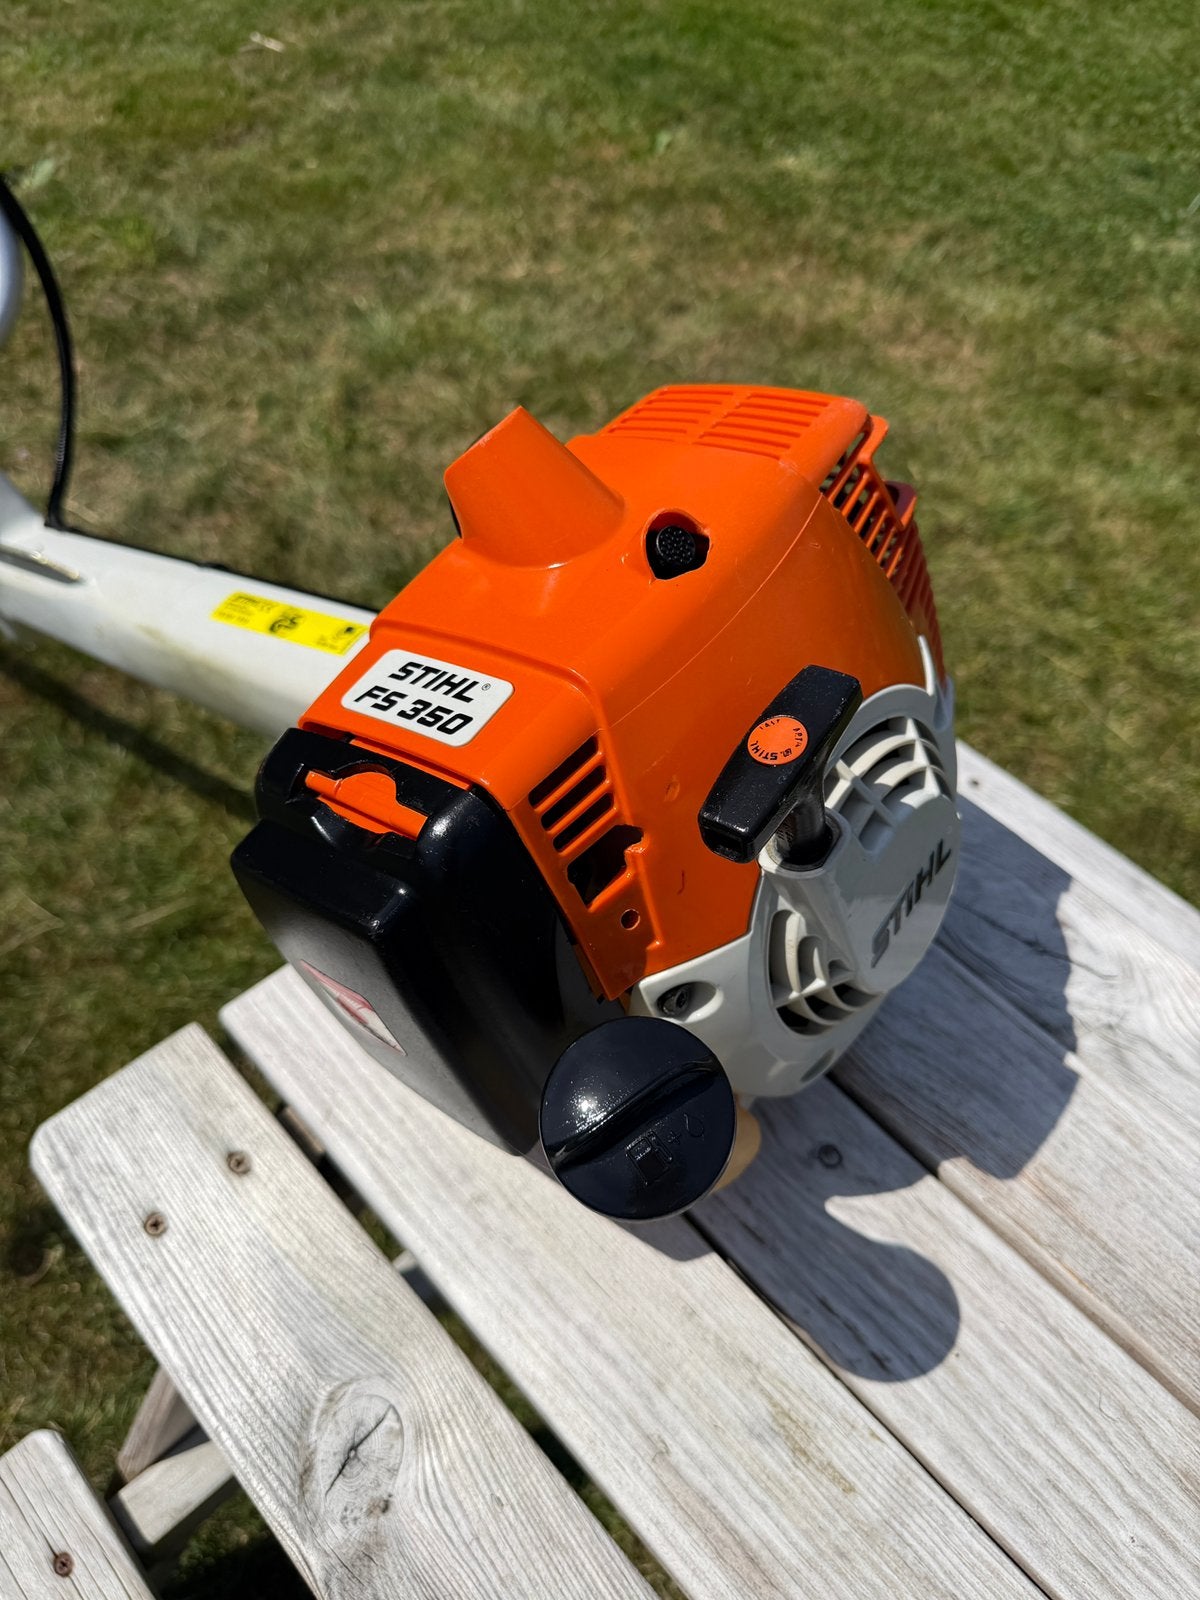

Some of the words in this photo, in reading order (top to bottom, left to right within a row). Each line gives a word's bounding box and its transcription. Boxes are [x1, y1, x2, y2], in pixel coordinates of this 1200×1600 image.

[388, 661, 479, 703] STIHL
[354, 685, 408, 711] FS
[397, 699, 473, 735] 350
[750, 740, 778, 761] STIHL
[871, 838, 952, 969] STIHL
